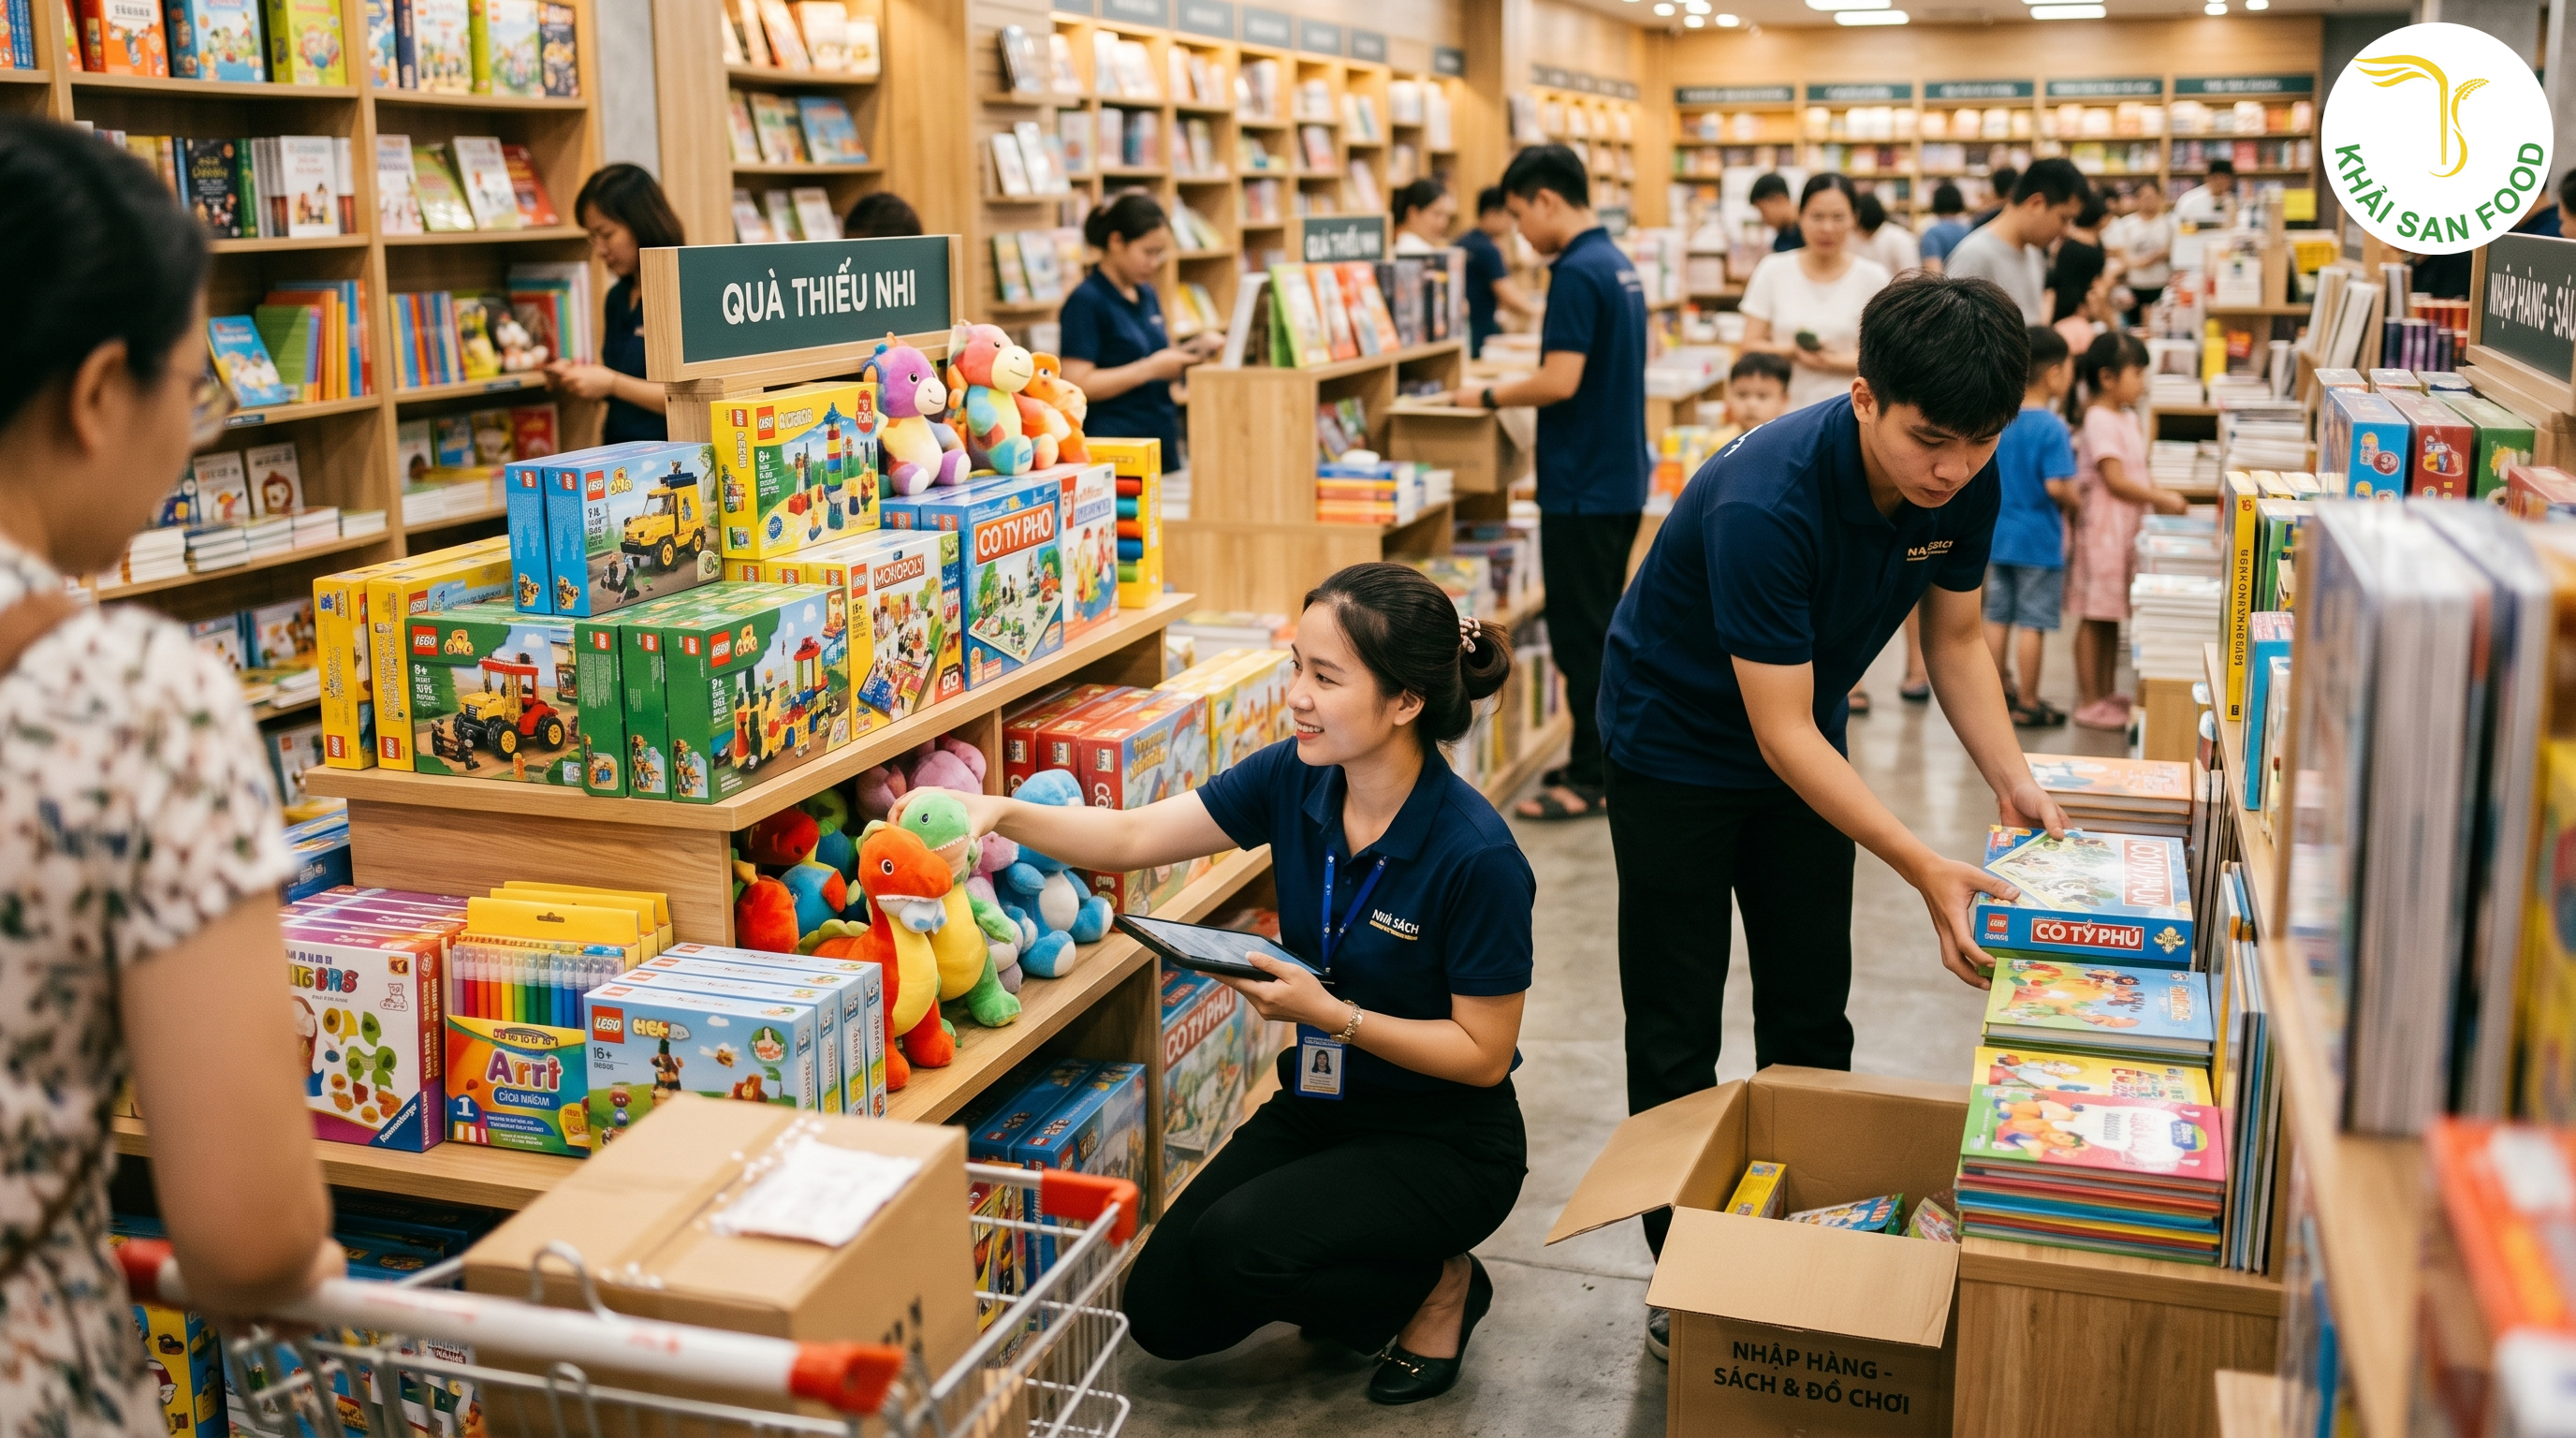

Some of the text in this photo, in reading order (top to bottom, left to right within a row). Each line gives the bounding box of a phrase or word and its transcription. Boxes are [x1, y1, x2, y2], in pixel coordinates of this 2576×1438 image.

[722, 257, 916, 325] QUÀ THIẾU NHI
[2489, 263, 2517, 330] NHẬP
[2516, 266, 2548, 331] HÀNG
[874, 556, 924, 587] MONOPOLY
[1393, 918, 1420, 934] SÁCH
[2098, 927, 2140, 946] PHÚ
[593, 1047, 613, 1060] 16+
[1733, 1341, 1801, 1371] NHẬP
[1807, 1350, 1878, 1380] HÀNG
[1713, 1365, 1910, 1415] SÁCH & ĐỒ CHƠI
